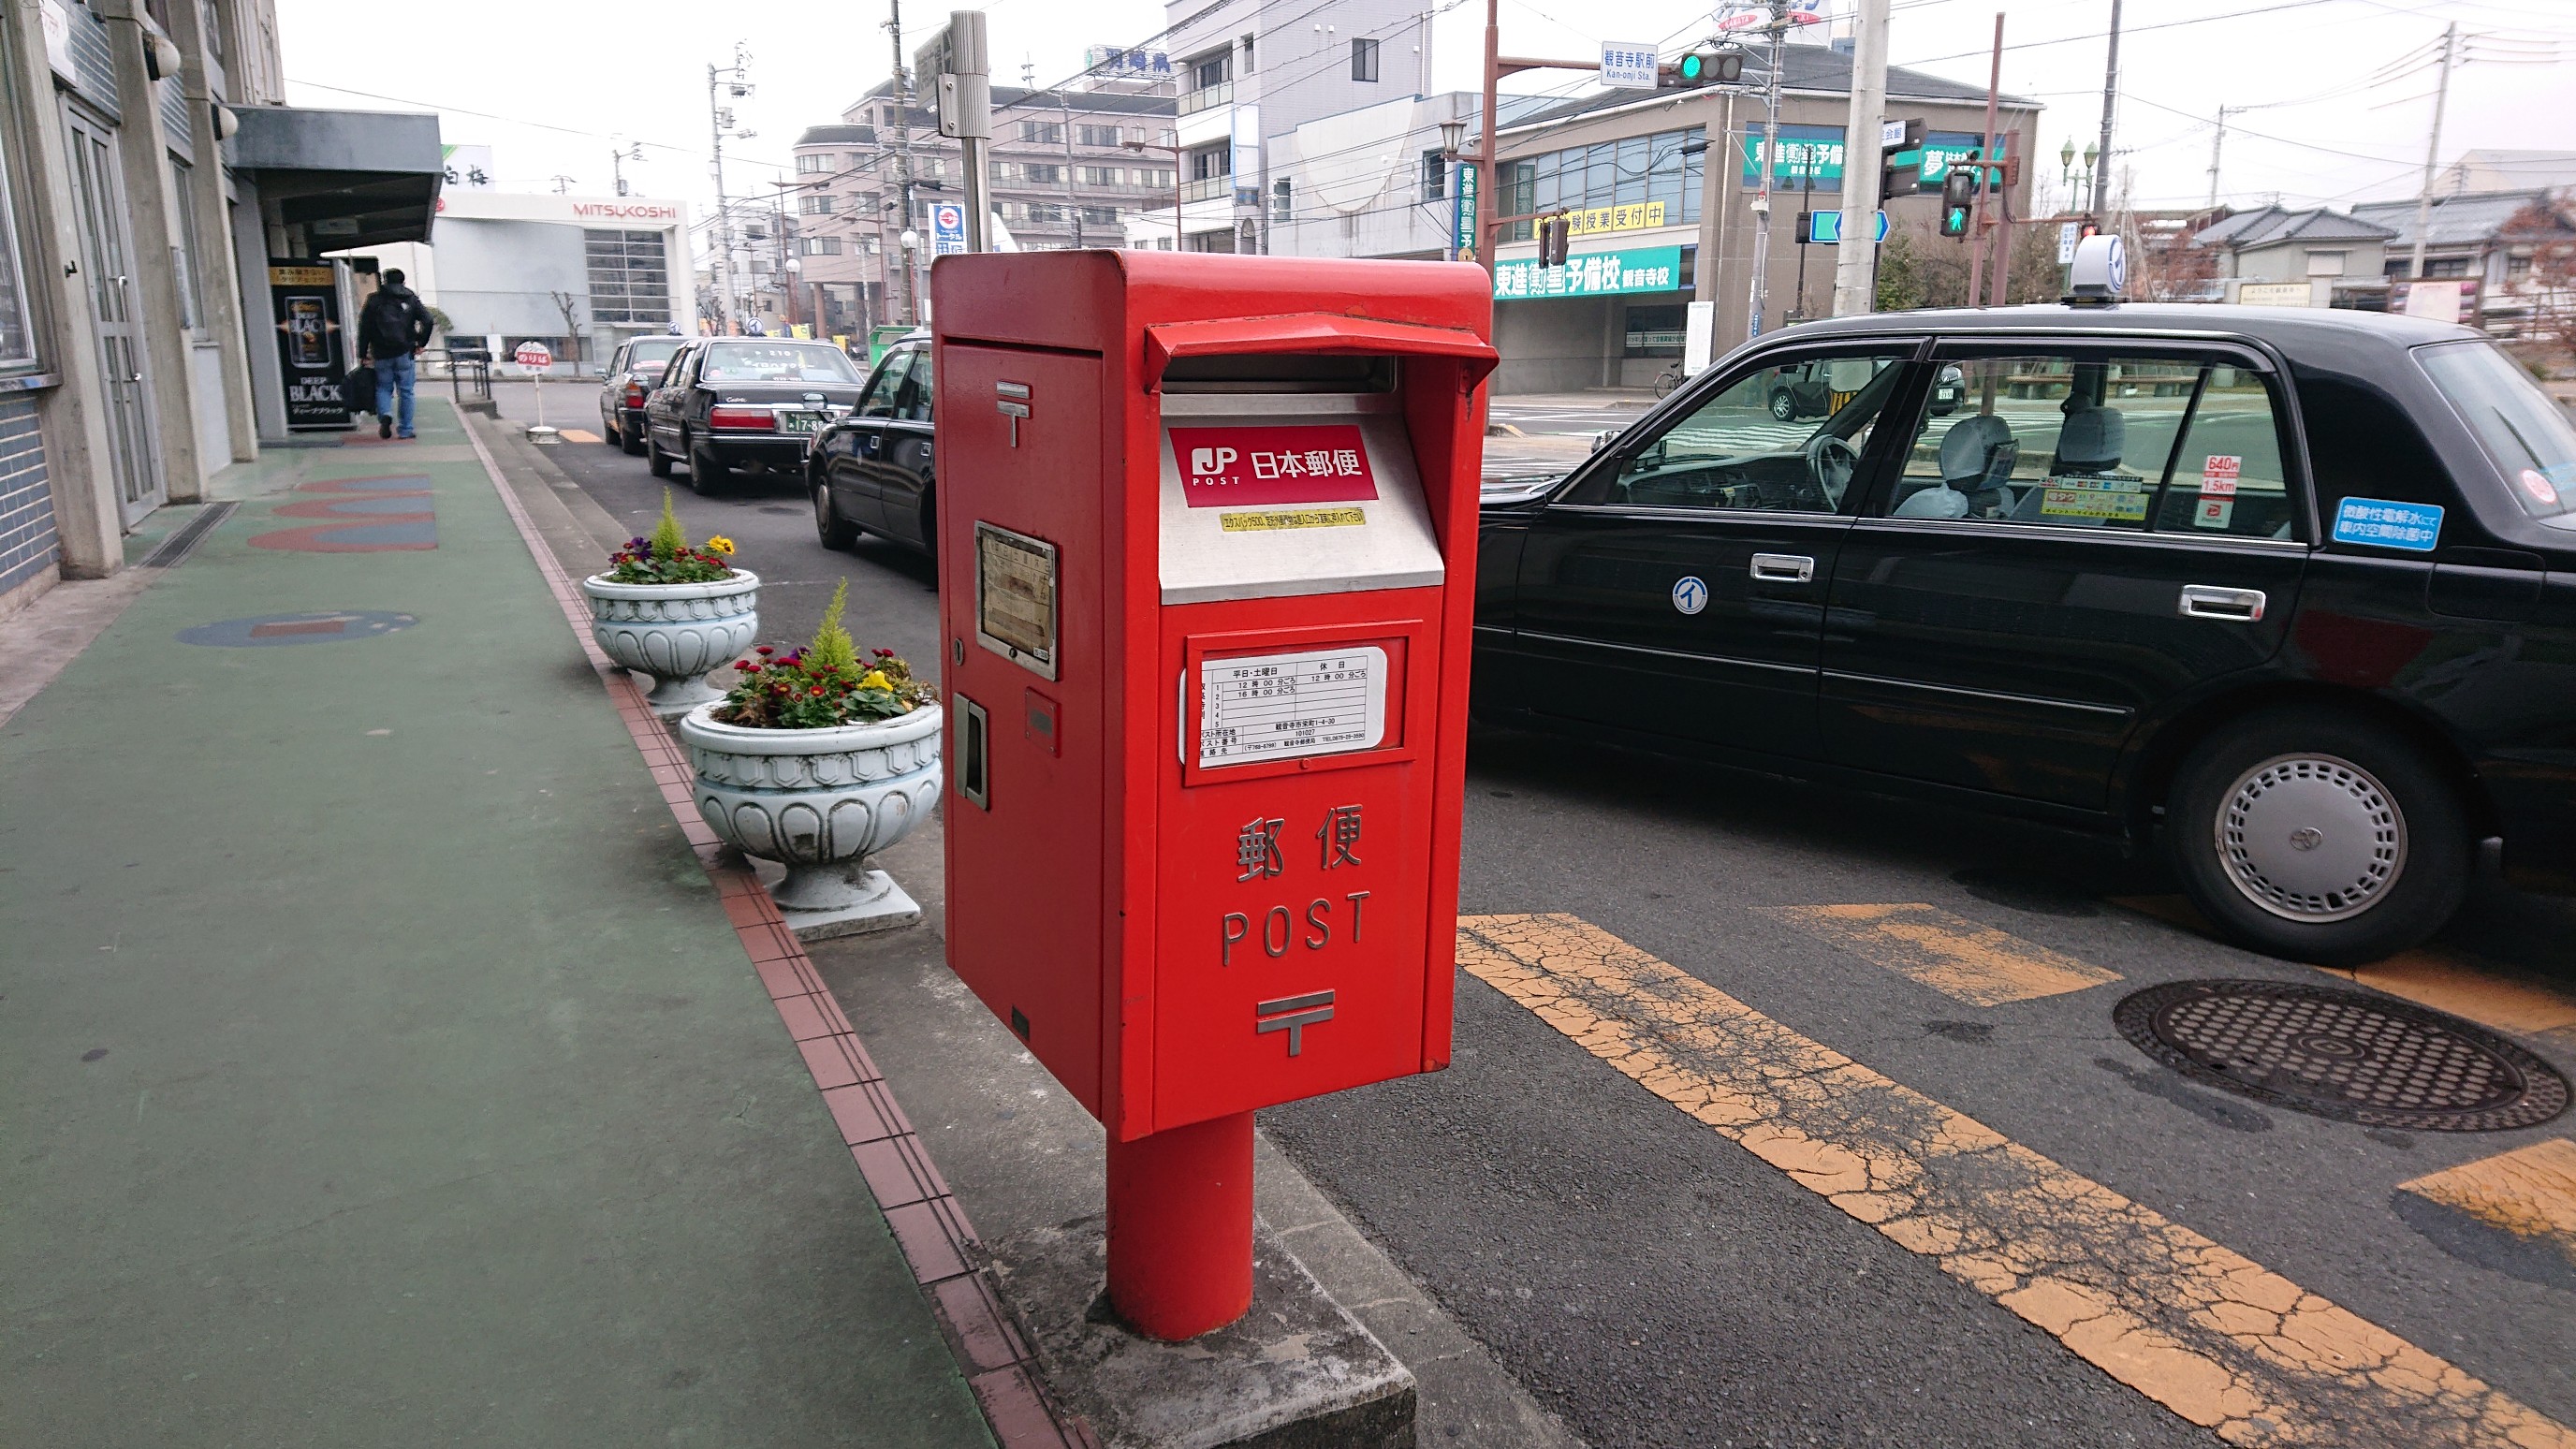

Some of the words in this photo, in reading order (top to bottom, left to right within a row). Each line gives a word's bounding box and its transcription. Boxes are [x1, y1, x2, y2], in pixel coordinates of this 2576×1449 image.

[1604, 50, 1655, 69] 観音寺駅前
[1606, 69, 1636, 80] Kan-onji
[1638, 71, 1651, 80] Sta.
[1881, 127, 1903, 140] 会館
[573, 203, 676, 218] MITSUKOSHI
[1496, 255, 1621, 296] 東進衛星予備校
[1622, 267, 1669, 287] 観音寺校
[289, 385, 344, 402] BLACK
[1251, 449, 1363, 479] 日本郵便
[1193, 476, 1240, 486] POST
[1233, 667, 1278, 680] 平日・土曜日
[1237, 804, 1364, 883] 郵便
[1222, 890, 1371, 967] POST
